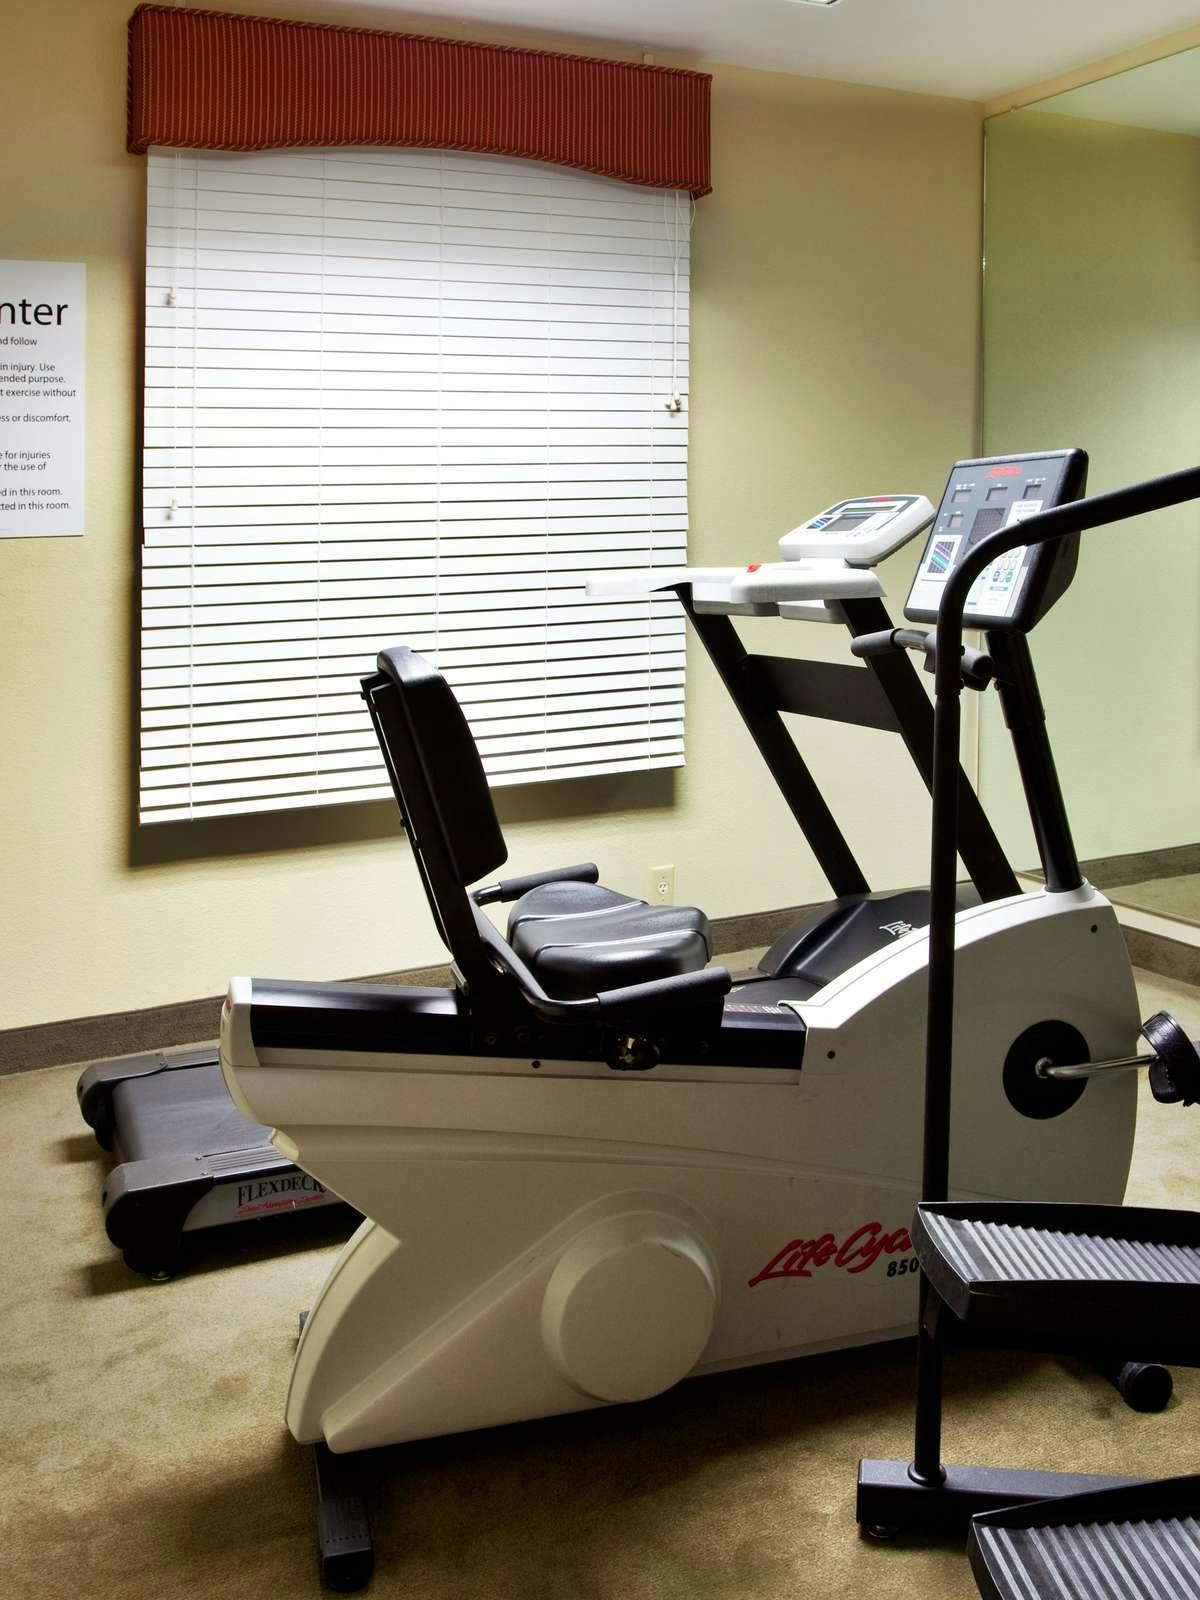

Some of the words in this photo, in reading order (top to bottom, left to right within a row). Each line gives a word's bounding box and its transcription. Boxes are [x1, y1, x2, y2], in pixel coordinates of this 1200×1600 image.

[0, 298, 69, 326] nter
[10, 336, 38, 346] follow
[10, 362, 38, 374] injury.
[39, 363, 56, 373] Use
[28, 374, 67, 385] purpose.
[6, 388, 41, 398] exercise
[42, 388, 77, 398] without
[0, 414, 10, 423] ss
[11, 414, 21, 423] or
[22, 412, 72, 424] discomfort,
[4, 450, 18, 460] for
[18, 450, 51, 462] injuries
[4, 461, 18, 472] the
[20, 462, 36, 471] use
[37, 461, 48, 471] of
[0, 487, 7, 497] d
[9, 488, 18, 497] in
[19, 487, 36, 497] this
[37, 488, 64, 497] room.
[0, 501, 16, 511] ted
[18, 501, 27, 511] in
[28, 500, 45, 511] this
[46, 501, 71, 510] room.
[238, 1175, 326, 1208] FLEXDECK
